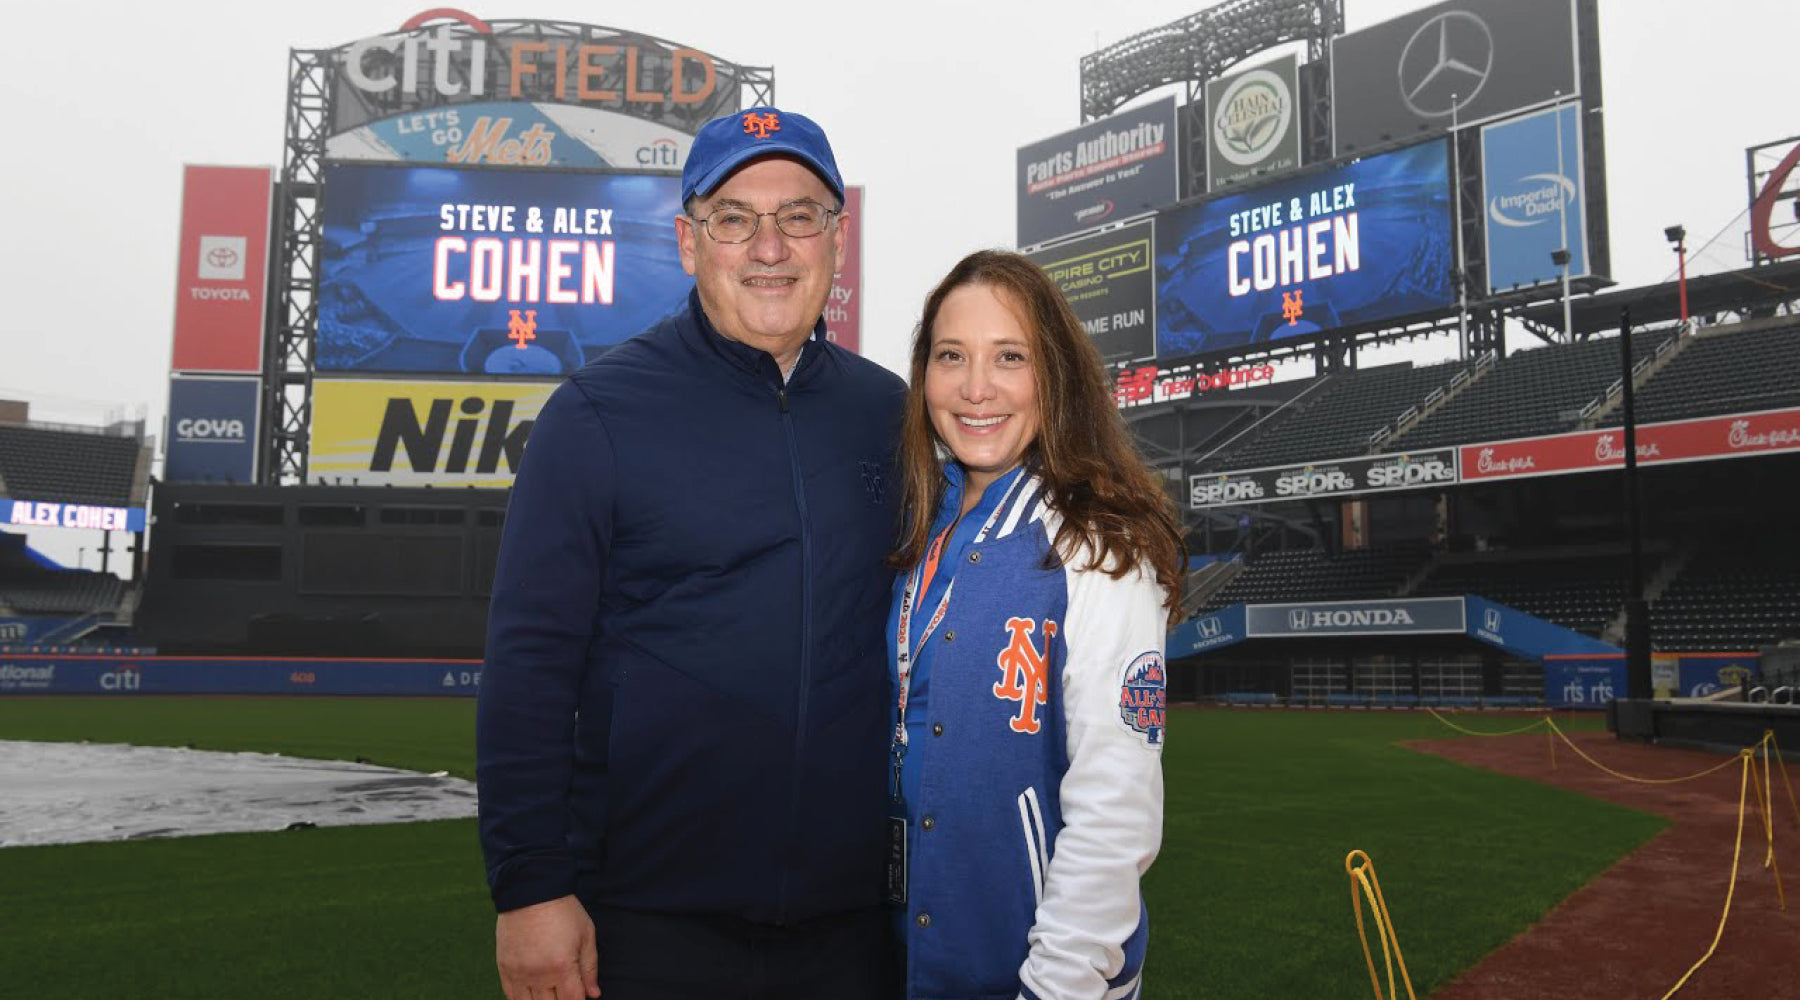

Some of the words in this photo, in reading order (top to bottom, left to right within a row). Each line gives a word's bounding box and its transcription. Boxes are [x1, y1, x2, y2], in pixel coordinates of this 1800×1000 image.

[345, 24, 486, 96] citi
[510, 42, 716, 104] FIELD
[1234, 93, 1269, 113] HAIN
[397, 110, 460, 134] LET'S
[432, 127, 462, 145] GO
[446, 116, 556, 166] Mets
[637, 146, 677, 165] citi
[1027, 150, 1073, 185] Parts
[1075, 122, 1165, 169] Authority
[1501, 182, 1558, 209] Imperial
[439, 204, 515, 232] STEVE
[525, 207, 543, 233] &
[553, 207, 613, 235] ALEX
[1230, 202, 1283, 237] STEVE
[1290, 197, 1303, 222] &
[1310, 182, 1355, 217] ALEX
[1049, 262, 1094, 282] PIRE
[1098, 250, 1140, 271] CITY
[1228, 211, 1360, 297] COHEN
[432, 235, 616, 305] COHEN
[191, 287, 250, 301] TOYOTA
[1061, 275, 1103, 292] CASINO
[1112, 308, 1145, 331] RUN
[1162, 376, 1196, 397] new
[1199, 365, 1275, 391] balance
[177, 419, 244, 439] GOYA
[369, 396, 536, 474] Nik
[11, 500, 61, 526] ALEX
[63, 505, 128, 531] COHEN
[1312, 609, 1414, 627] HONDA
[1193, 634, 1233, 650] HONDA
[100, 670, 140, 690] citi
[460, 672, 482, 686] DE
